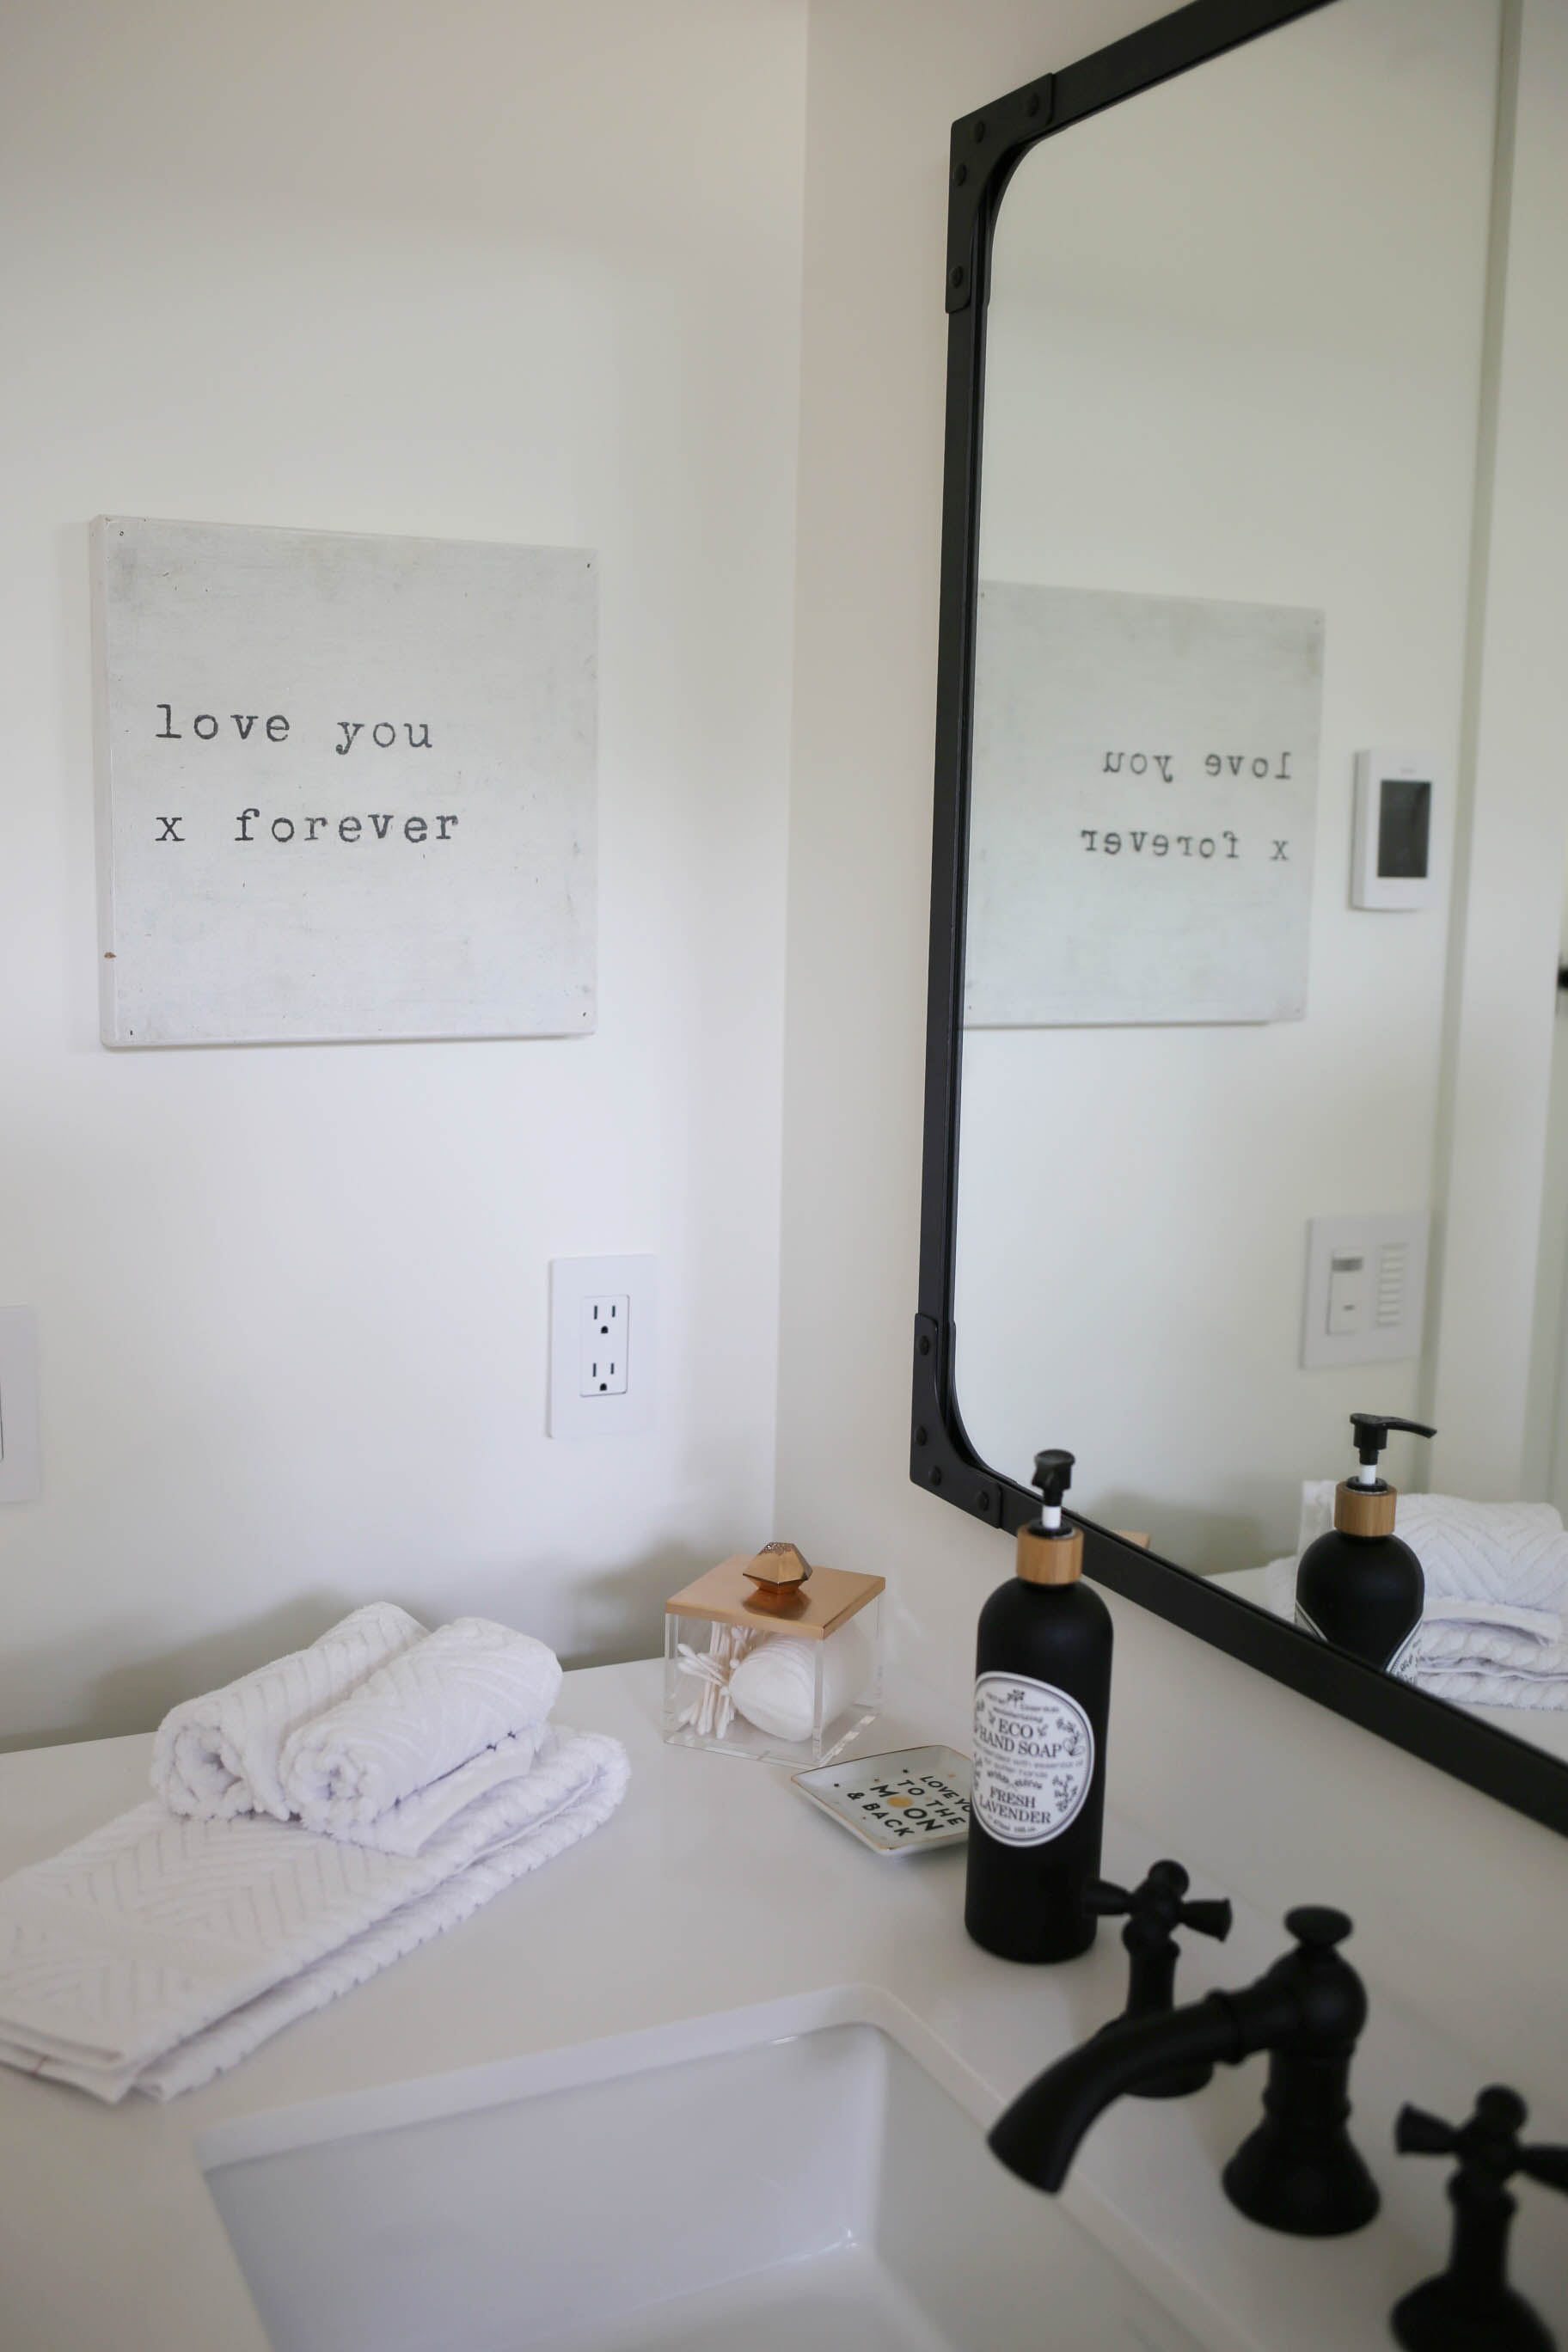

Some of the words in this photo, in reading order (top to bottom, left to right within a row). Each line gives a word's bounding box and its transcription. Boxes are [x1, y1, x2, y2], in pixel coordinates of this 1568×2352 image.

[156, 703, 291, 742] love
[335, 721, 432, 756] you
[155, 816, 186, 842] x
[234, 808, 459, 842] forever
[979, 1724, 1014, 1752] HAND
[1018, 1740, 1063, 1758] SOAP
[998, 1718, 1033, 1738] ECO
[897, 1779, 925, 1796] TO
[926, 1800, 966, 1826] THE
[919, 1775, 959, 1799] LOVE
[954, 1798, 971, 1813] YO
[979, 1794, 1051, 1825] LAVENDER
[990, 1785, 1037, 1809] FRESH
[862, 1803, 915, 1837] BACK
